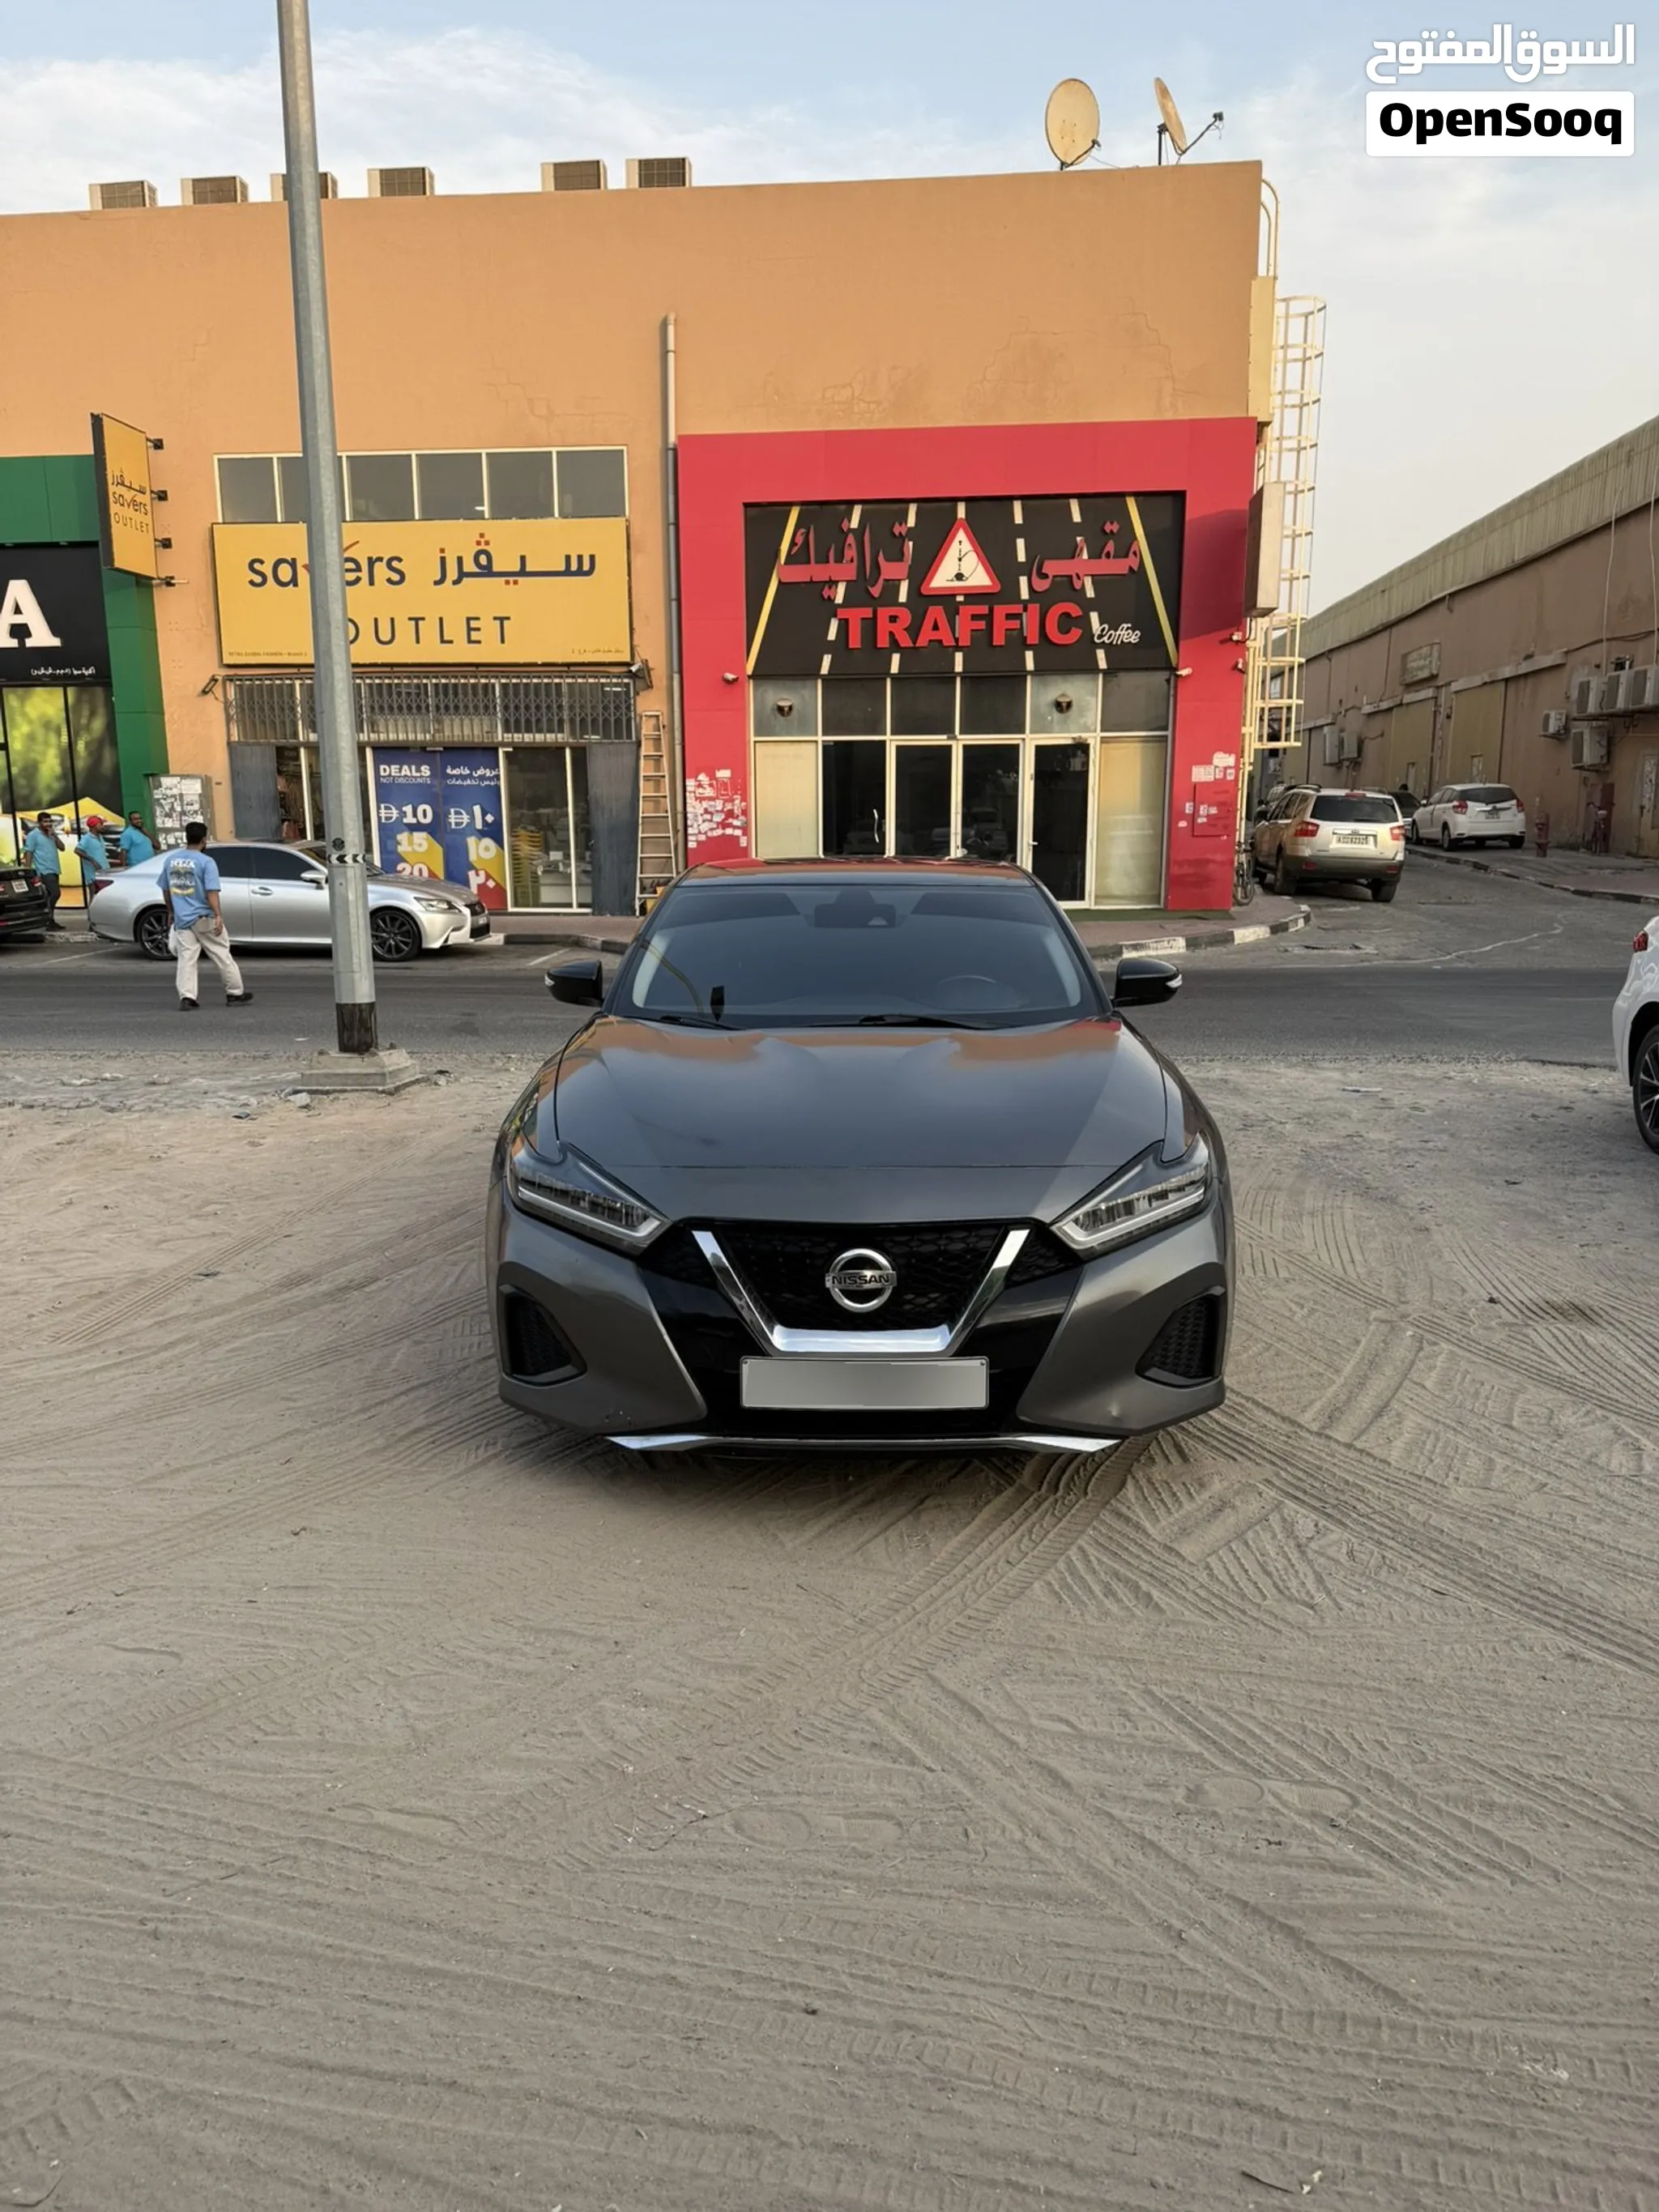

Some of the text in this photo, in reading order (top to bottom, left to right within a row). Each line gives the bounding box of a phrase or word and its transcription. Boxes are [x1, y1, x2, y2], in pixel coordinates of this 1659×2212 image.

[112, 491, 148, 516] savers
[113, 512, 150, 535] OUTLET
[247, 539, 407, 589] saers
[775, 517, 912, 601] ترافيك
[835, 601, 1084, 651] TRAFFIC
[1093, 620, 1141, 645] Coffee
[379, 764, 432, 778] DEALS
[394, 777, 432, 785] DISCOUNTS
[446, 765, 471, 775] خاصة
[402, 803, 433, 825] 10
[396, 831, 429, 853] 15
[831, 1274, 890, 1285] NISSAN
